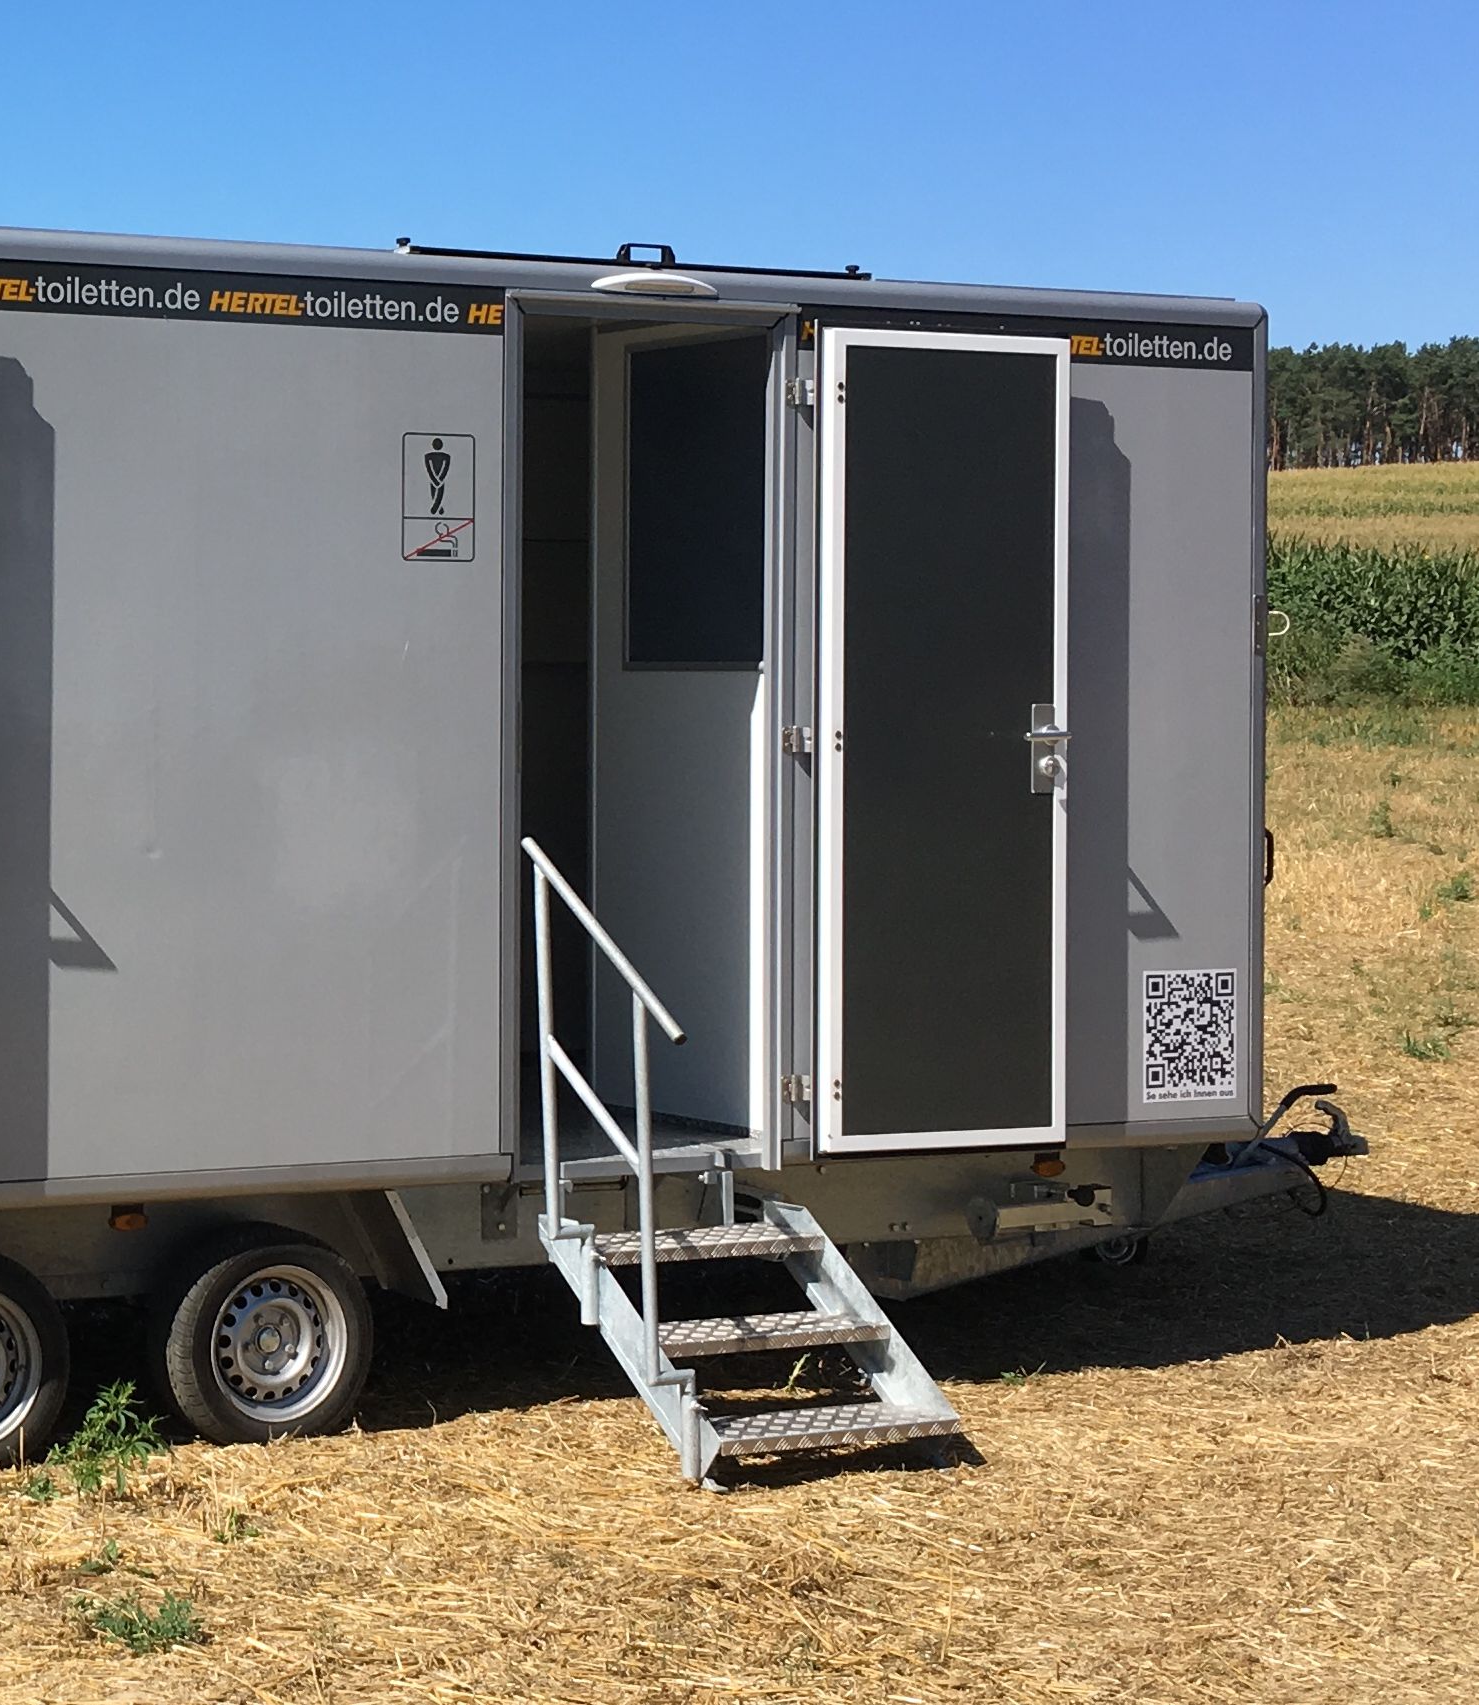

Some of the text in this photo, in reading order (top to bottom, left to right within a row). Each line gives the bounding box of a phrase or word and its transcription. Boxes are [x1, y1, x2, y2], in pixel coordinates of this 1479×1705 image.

[209, 290, 459, 323] HERTEL-toiletten.de
[467, 303, 504, 325] HE
[1070, 332, 1232, 361] TEL-toiletten.de
[1146, 1091, 1156, 1100] So
[1158, 1090, 1178, 1099] sehe
[1180, 1088, 1191, 1098] ich
[1219, 1089, 1233, 1097] aus
